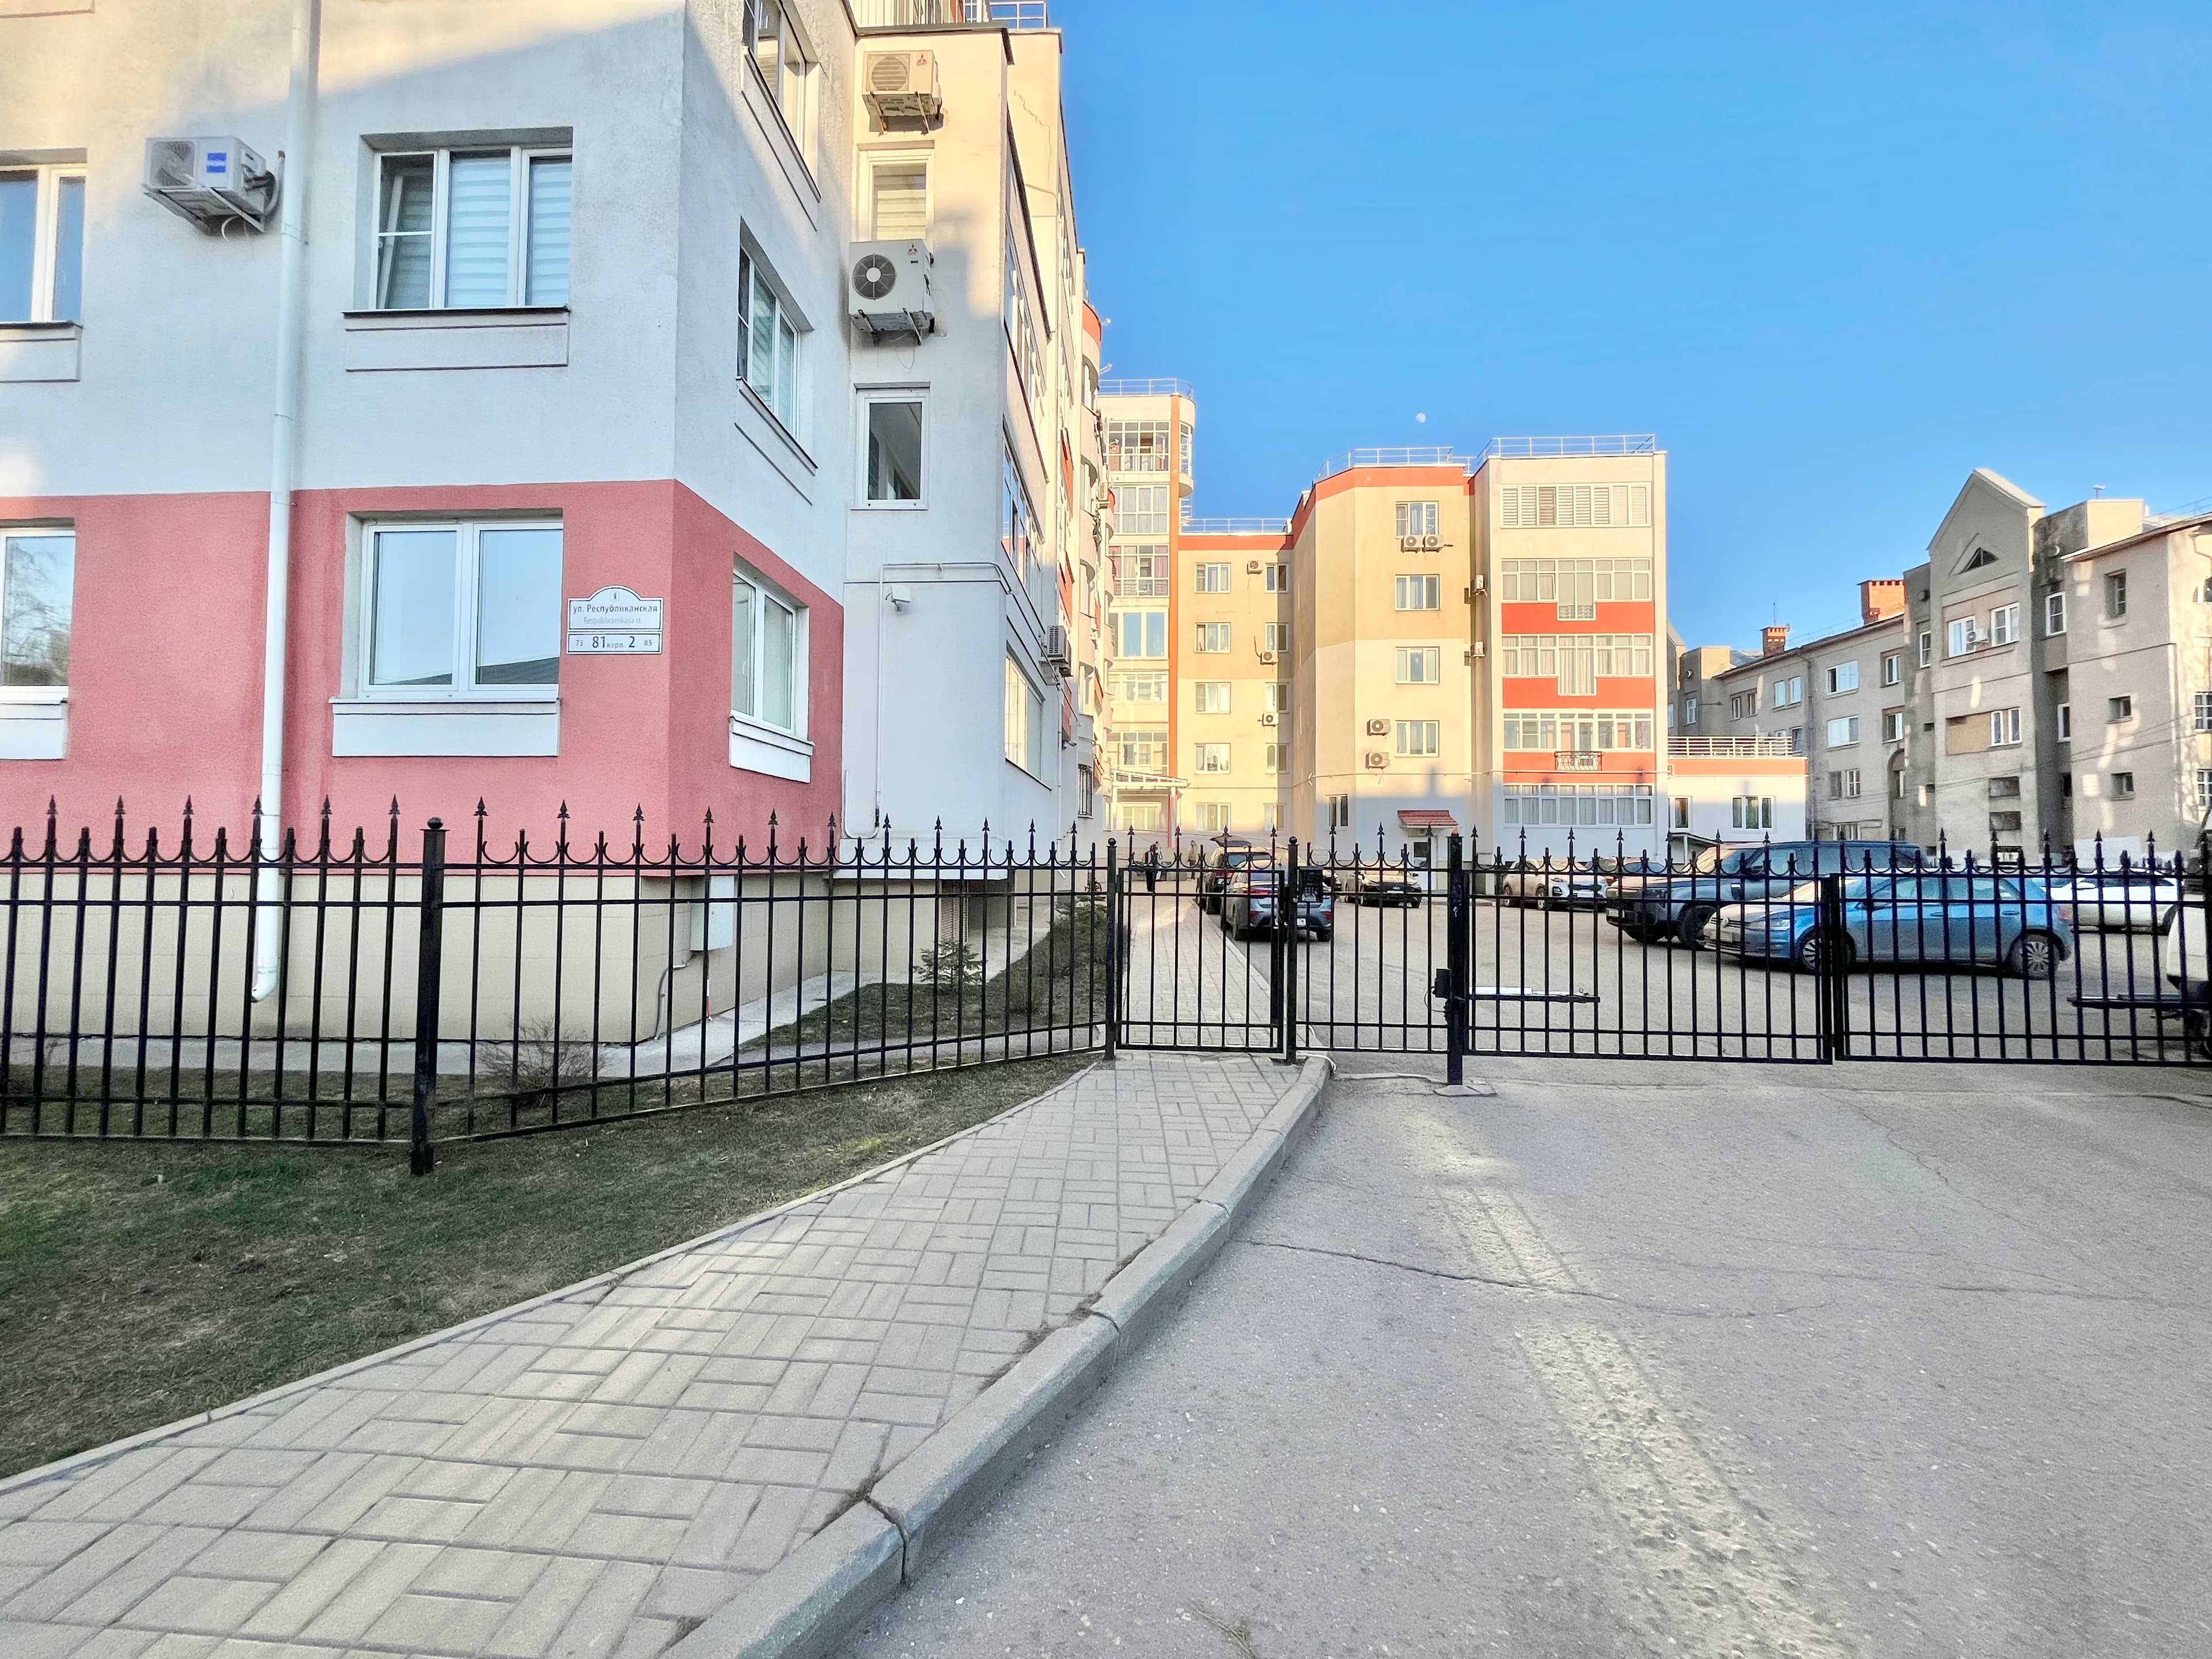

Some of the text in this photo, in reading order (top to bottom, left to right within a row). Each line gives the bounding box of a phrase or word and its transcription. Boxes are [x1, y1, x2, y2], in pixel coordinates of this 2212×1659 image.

[573, 604, 657, 615] ул. Республиканская
[592, 636, 605, 648] 81
[628, 636, 635, 648] 2
